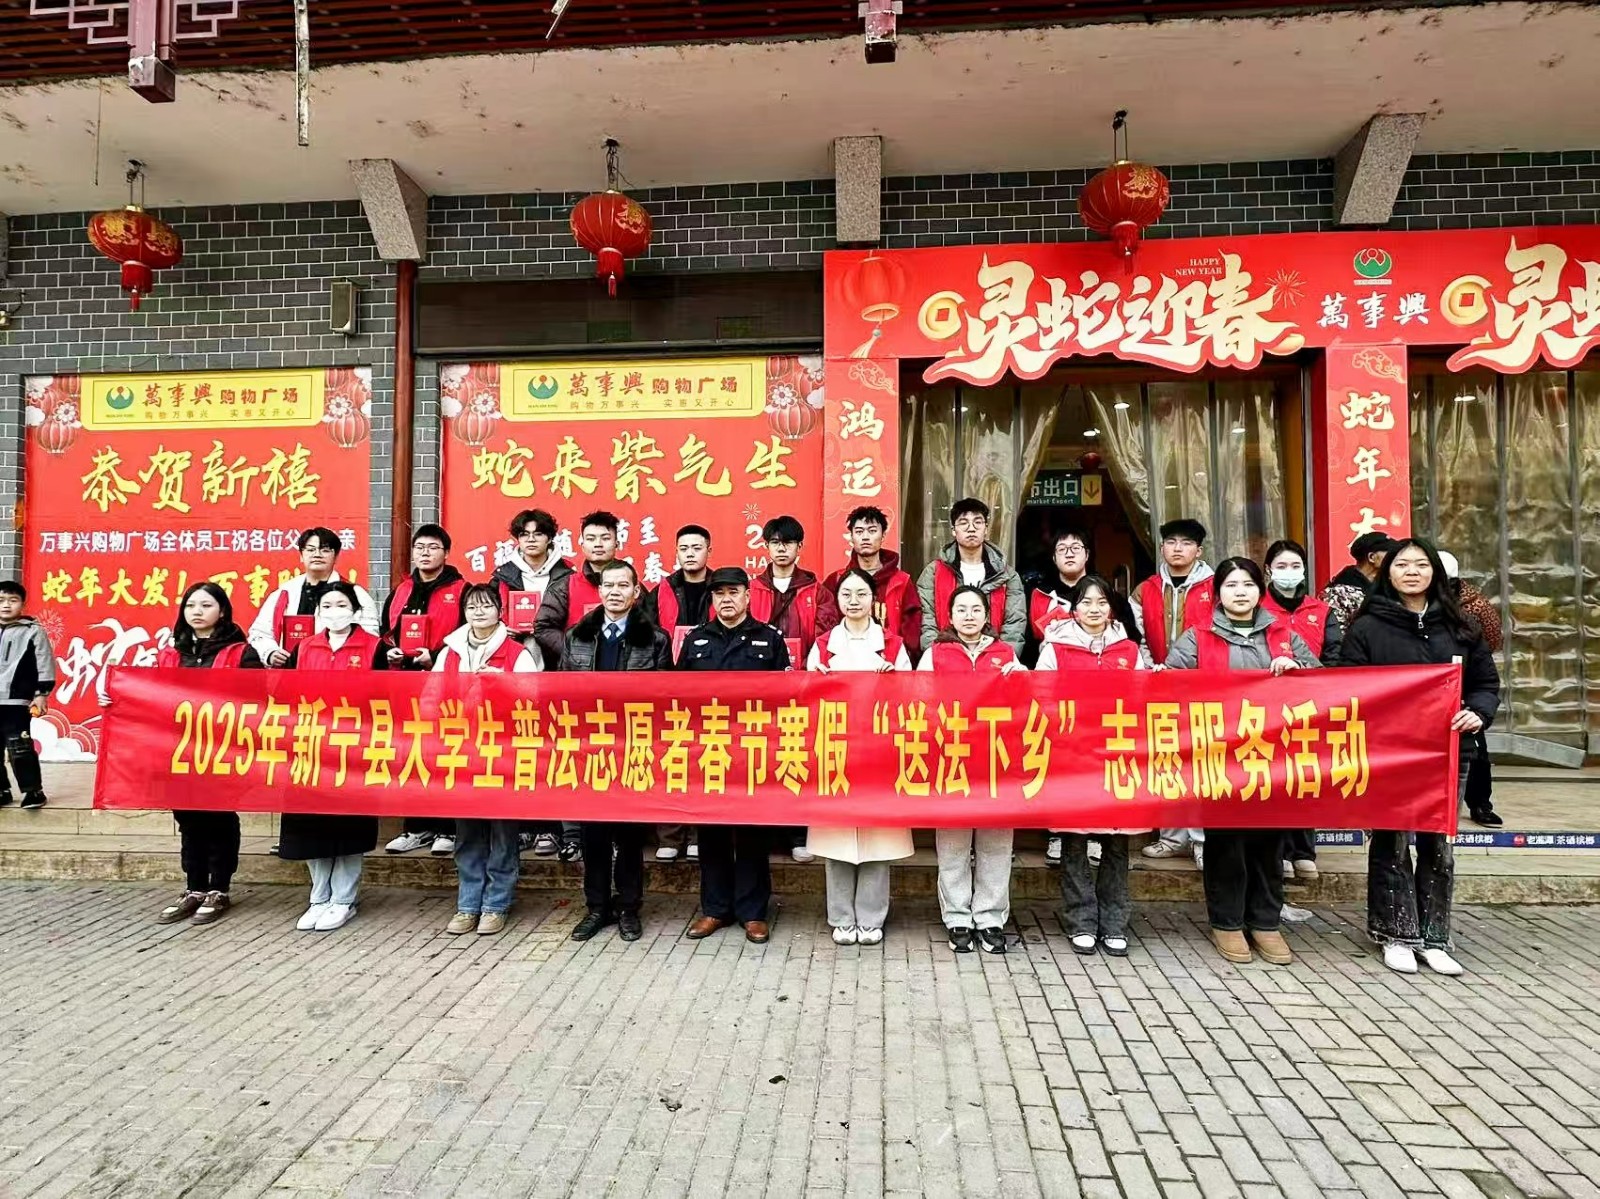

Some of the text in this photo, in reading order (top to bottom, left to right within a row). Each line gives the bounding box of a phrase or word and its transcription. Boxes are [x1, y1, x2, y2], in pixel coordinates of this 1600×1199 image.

[1175, 267, 1223, 277] NEW YEAR
[1189, 257, 1221, 267] HAPPY
[926, 248, 1300, 381] 灵蛇迎春
[1316, 290, 1431, 330] 萬事興
[81, 440, 322, 514] 恭贺新禧
[471, 429, 798, 504] 蛇来紫气生
[39, 528, 356, 553] 万事兴购物广场全体员工祝各位父亲
